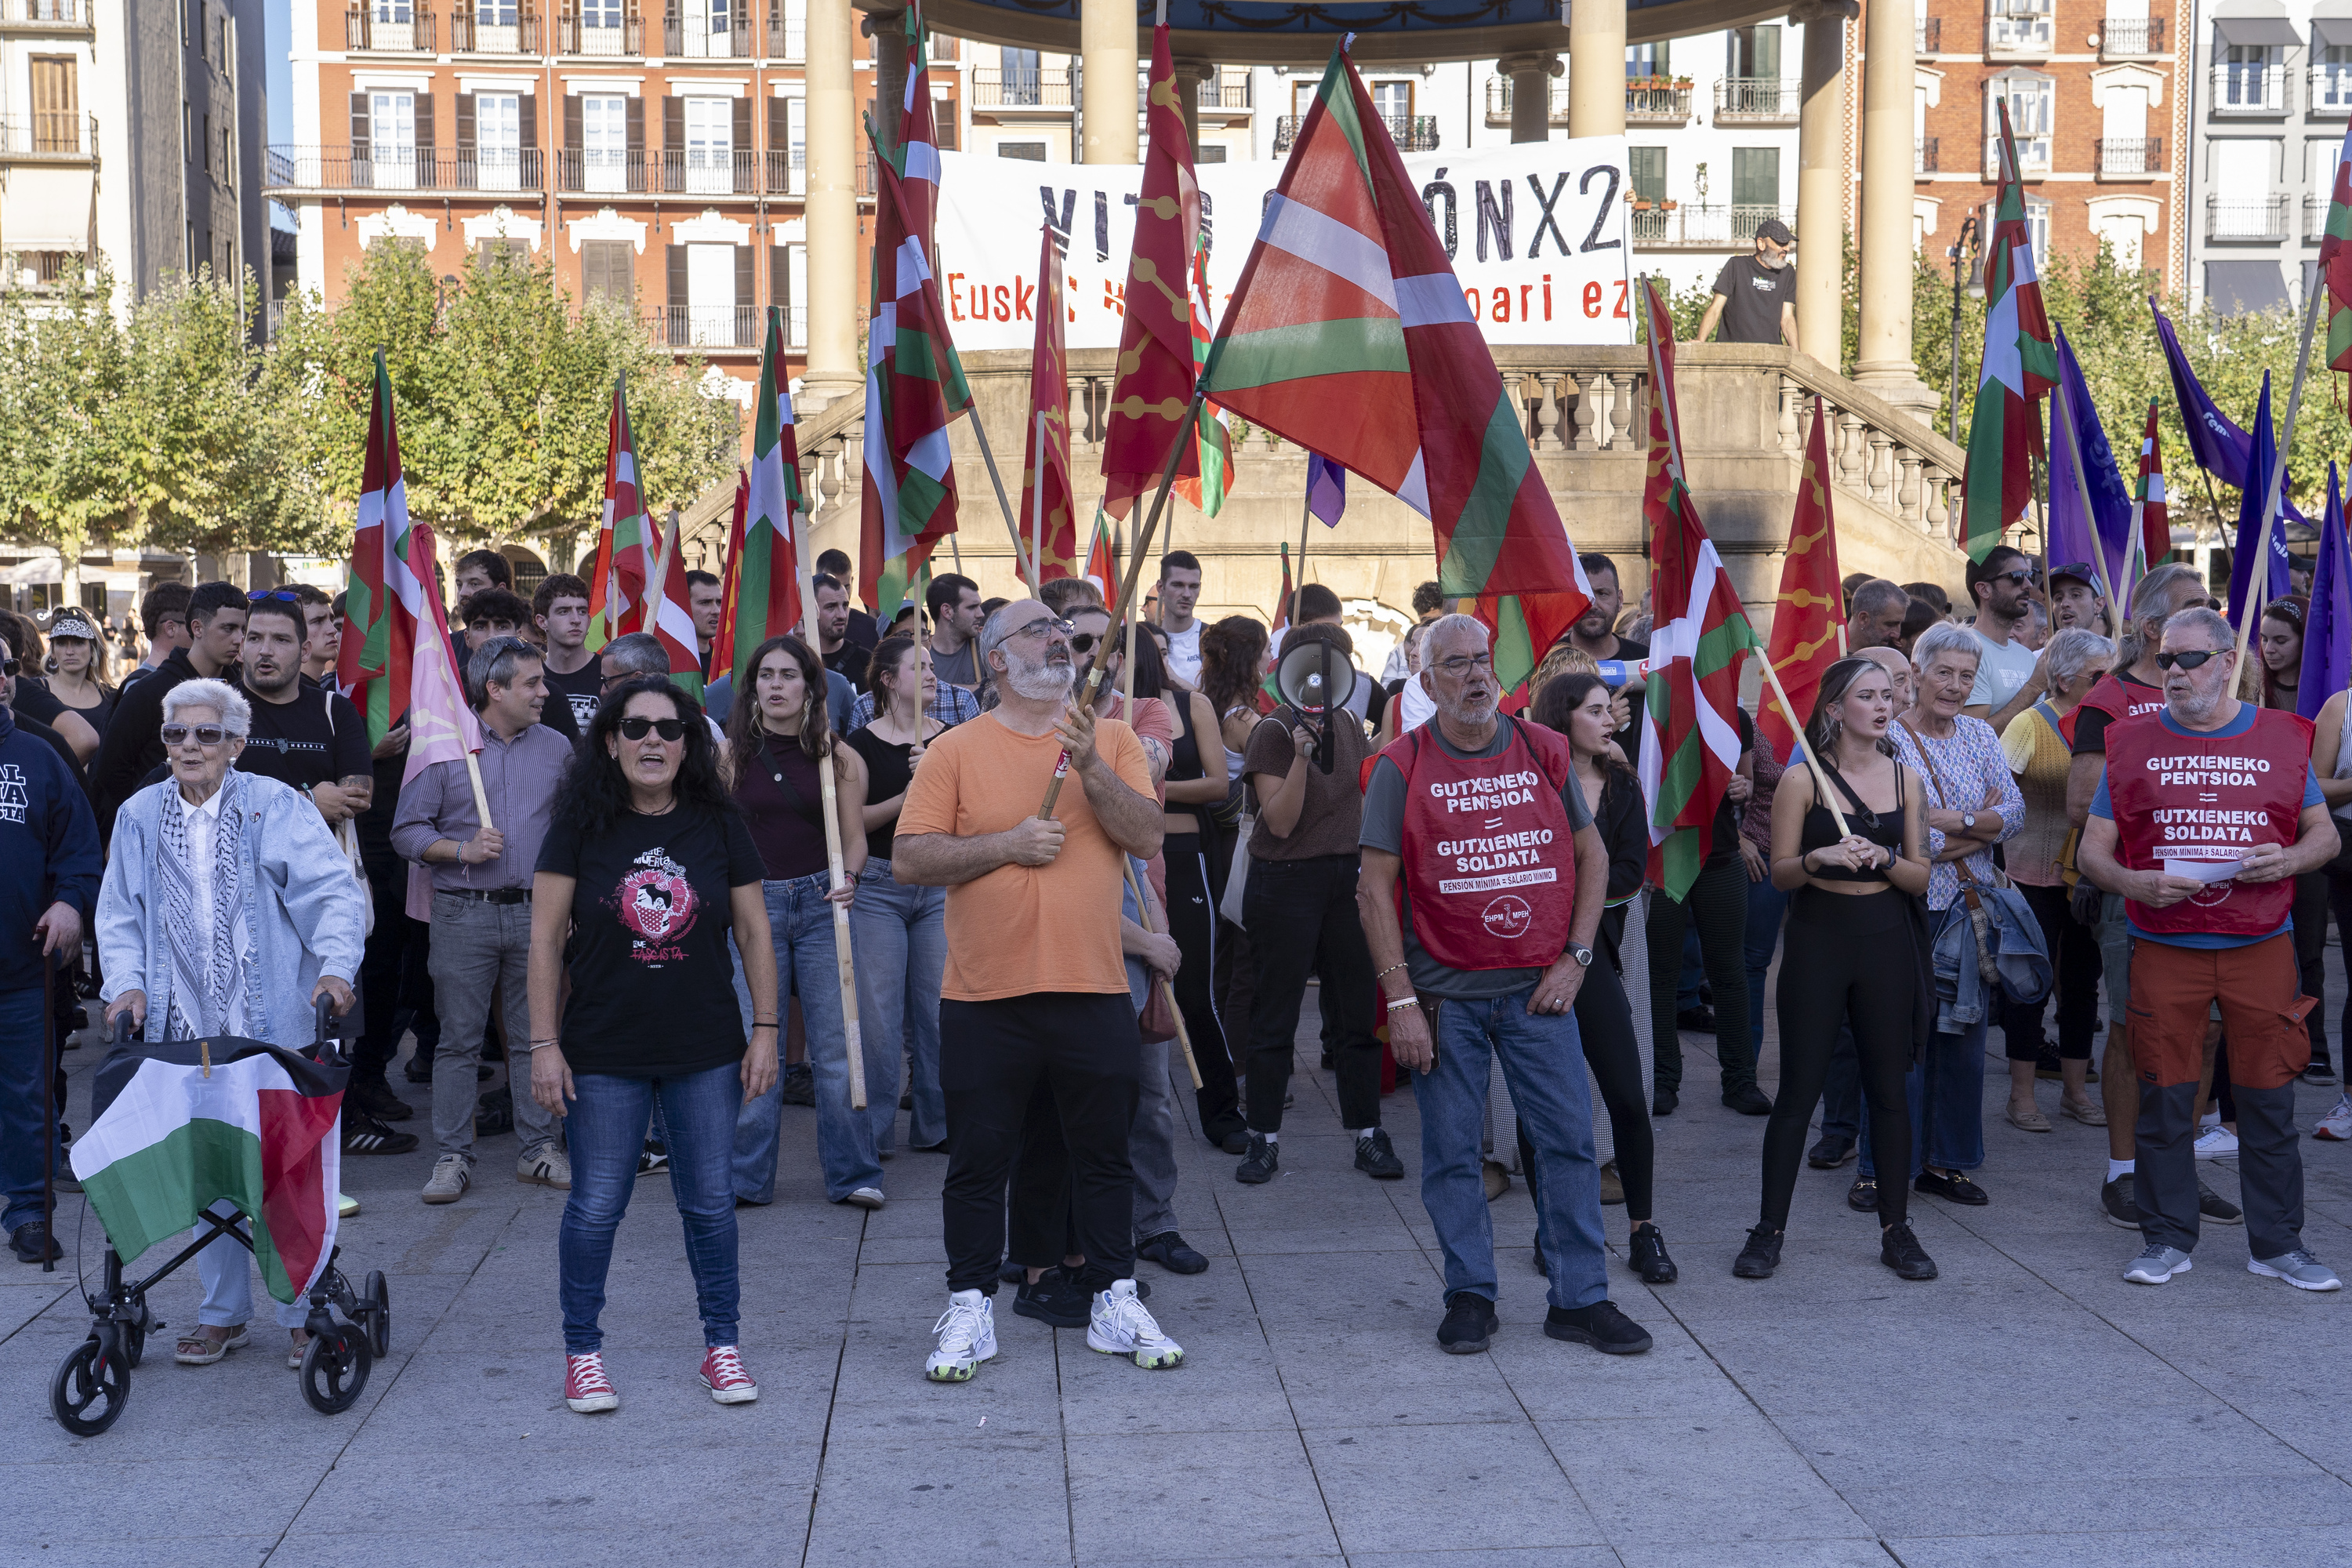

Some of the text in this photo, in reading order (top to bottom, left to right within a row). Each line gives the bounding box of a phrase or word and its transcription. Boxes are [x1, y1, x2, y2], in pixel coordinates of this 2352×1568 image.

[1582, 279, 1629, 319] ez
[2146, 755, 2271, 773] GUTXIENEKO
[2161, 771, 2257, 786] PENTSIOA
[1446, 788, 1535, 814] PENTSIOA
[2152, 809, 2269, 826] GUTXIENEKO
[1436, 829, 1554, 856] GUTXIENEKO
[2164, 826, 2253, 842] SOLDATA
[2155, 847, 2178, 857] PENSIÓN
[2179, 845, 2203, 857] MÍNIMA
[1456, 848, 1541, 873] SOLDATA
[1443, 879, 1474, 892] PENSIÓN
[1475, 877, 1501, 891] MÍNIMA
[1508, 873, 1533, 885] SALARIO
[1534, 869, 1553, 882] MÍNIMO
[1484, 909, 1530, 923] EHPM MPEH
